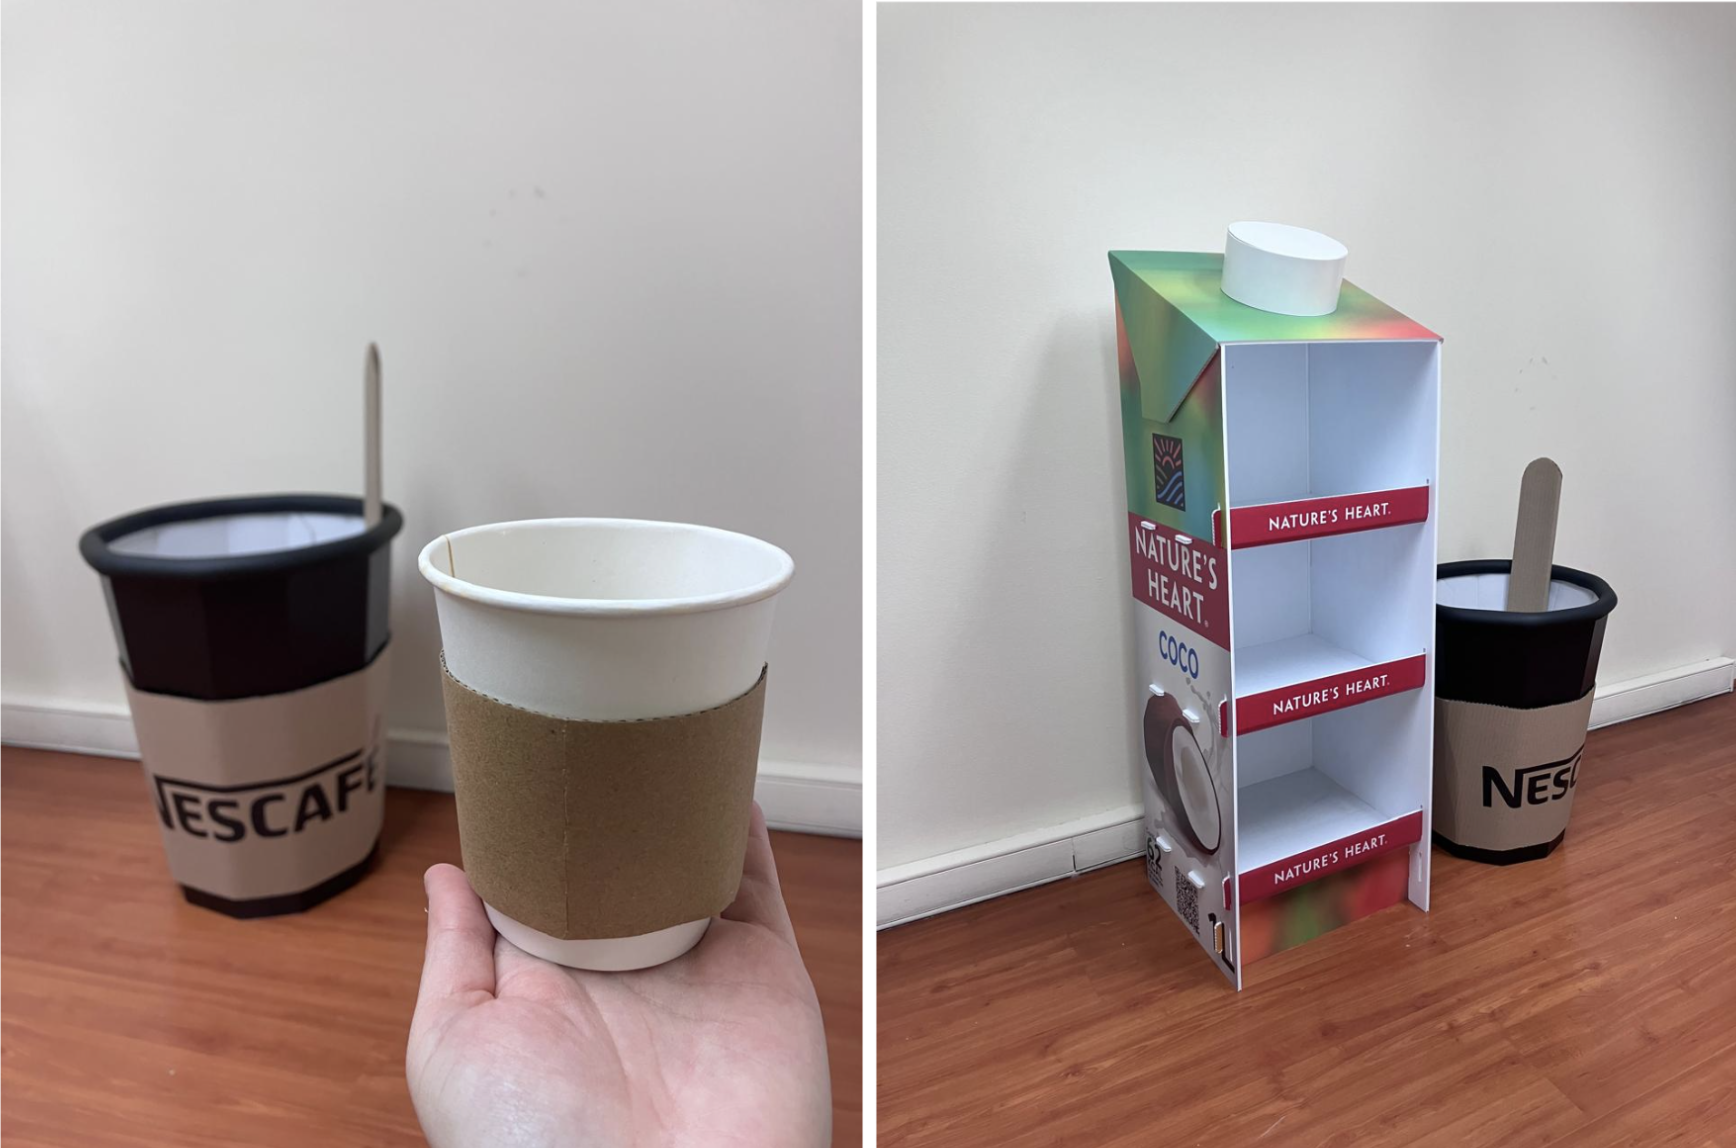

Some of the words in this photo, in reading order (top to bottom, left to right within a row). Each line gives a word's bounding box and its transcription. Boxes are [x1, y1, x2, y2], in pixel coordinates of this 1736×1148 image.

[1268, 509, 1338, 532] NATURE'S
[1135, 526, 1218, 590] NATURE'S
[1158, 631, 1198, 679] COCO
[1272, 686, 1339, 716] NATURE'S
[1273, 851, 1338, 885] NATURE'S
